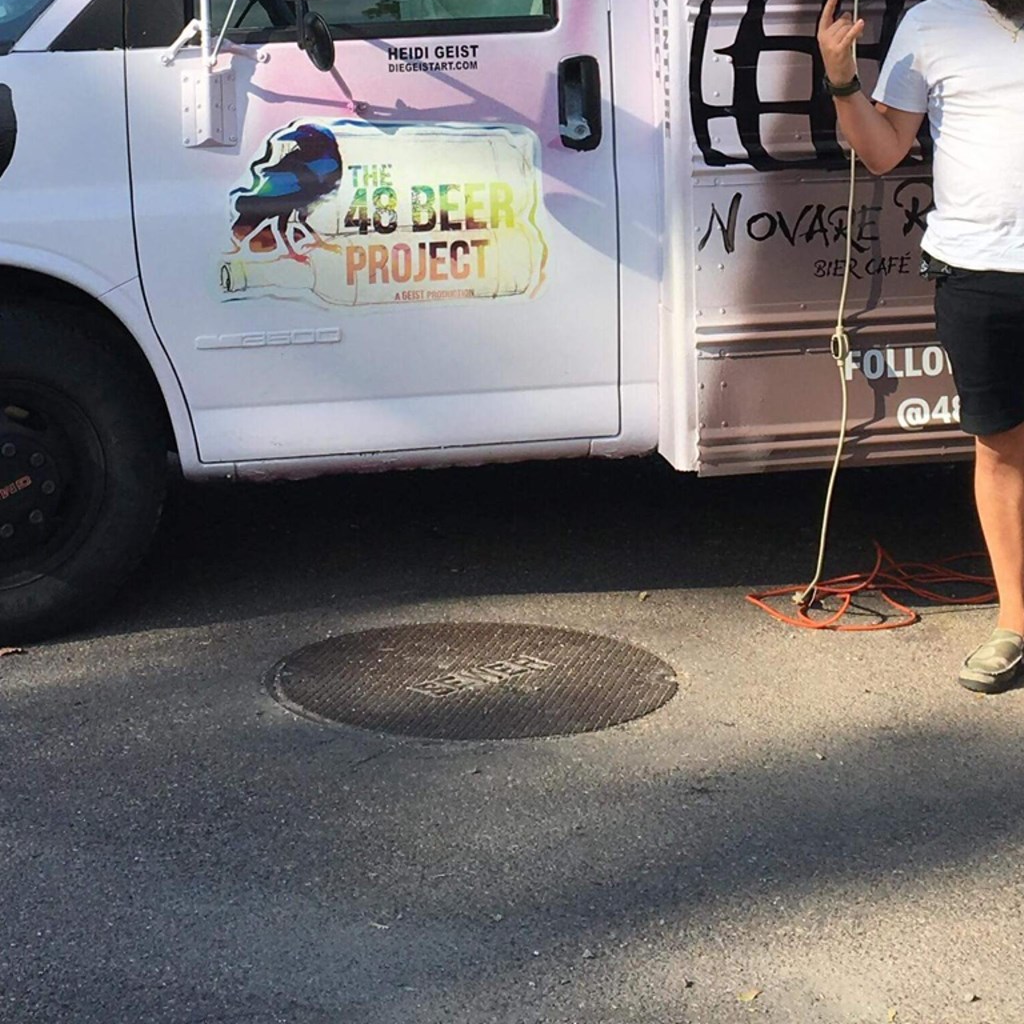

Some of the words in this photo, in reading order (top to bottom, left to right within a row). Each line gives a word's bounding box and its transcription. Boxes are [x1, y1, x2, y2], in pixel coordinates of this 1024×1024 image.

[388, 47, 429, 60] HEIDI
[434, 45, 479, 58] GEIST
[388, 61, 478, 72] DIEGEISTART.COM
[348, 164, 392, 187] THE
[344, 184, 398, 236] 48
[411, 183, 514, 233] BEER
[697, 192, 882, 254] NOVARE
[346, 240, 490, 285] PROJECT
[814, 259, 861, 280] BIER
[864, 252, 911, 276] CAFÉ
[395, 292, 401, 301] A
[402, 290, 425, 300] GEIST
[845, 345, 953, 380] FOLLO
